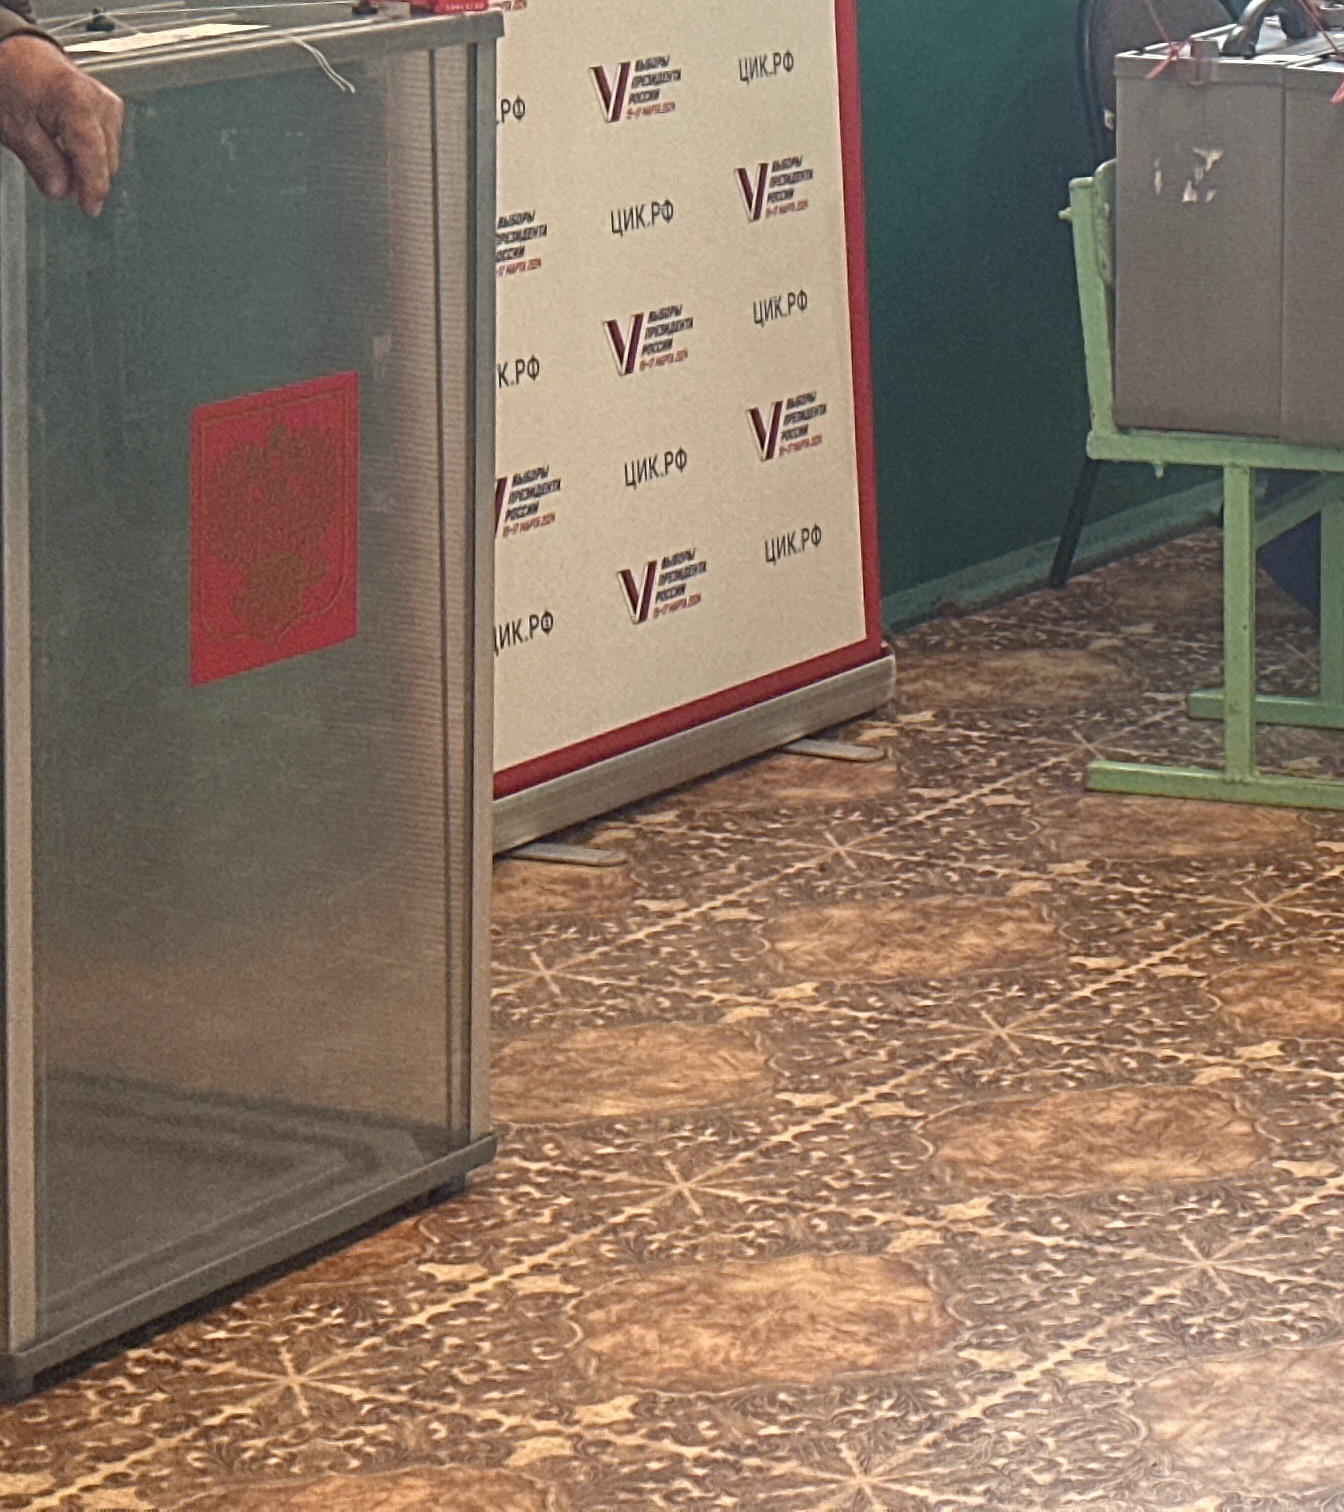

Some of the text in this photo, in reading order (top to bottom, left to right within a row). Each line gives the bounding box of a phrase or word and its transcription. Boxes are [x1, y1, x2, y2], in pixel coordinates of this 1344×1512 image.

[738, 49, 795, 85] ЦИК.РФ
[496, 95, 527, 127] .РФ
[611, 197, 674, 237] ЦИК.РФ
[753, 288, 808, 328] ЦИК.РФ
[498, 353, 541, 390] К.РФ
[624, 446, 687, 491] ЦИК.РФ
[764, 523, 822, 566] ЦИК.РФ
